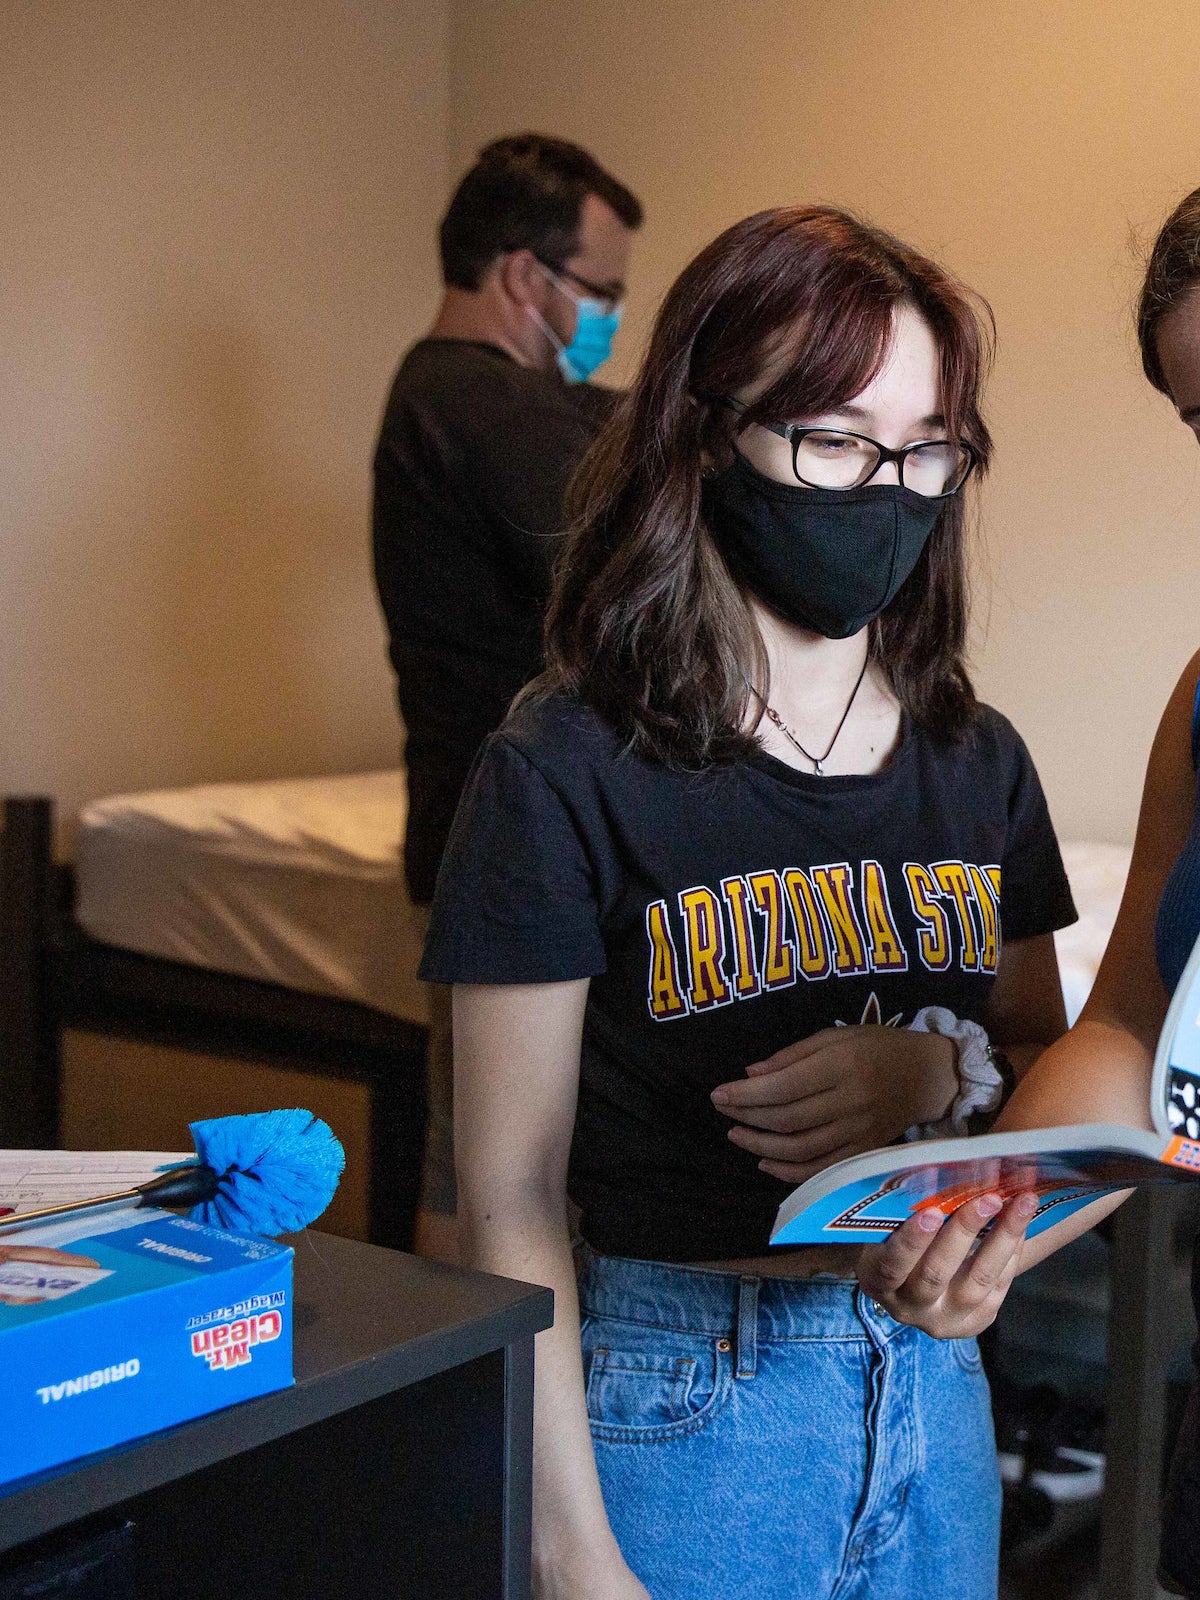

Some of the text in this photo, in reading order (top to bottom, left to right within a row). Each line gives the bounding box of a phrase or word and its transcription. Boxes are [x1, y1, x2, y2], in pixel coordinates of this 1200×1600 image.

[646, 860, 909, 1021] ARIZONA
[191, 1310, 282, 1357] Clean
[204, 1341, 252, 1372] Mr.
[36, 1358, 141, 1404] ORIGINAL
